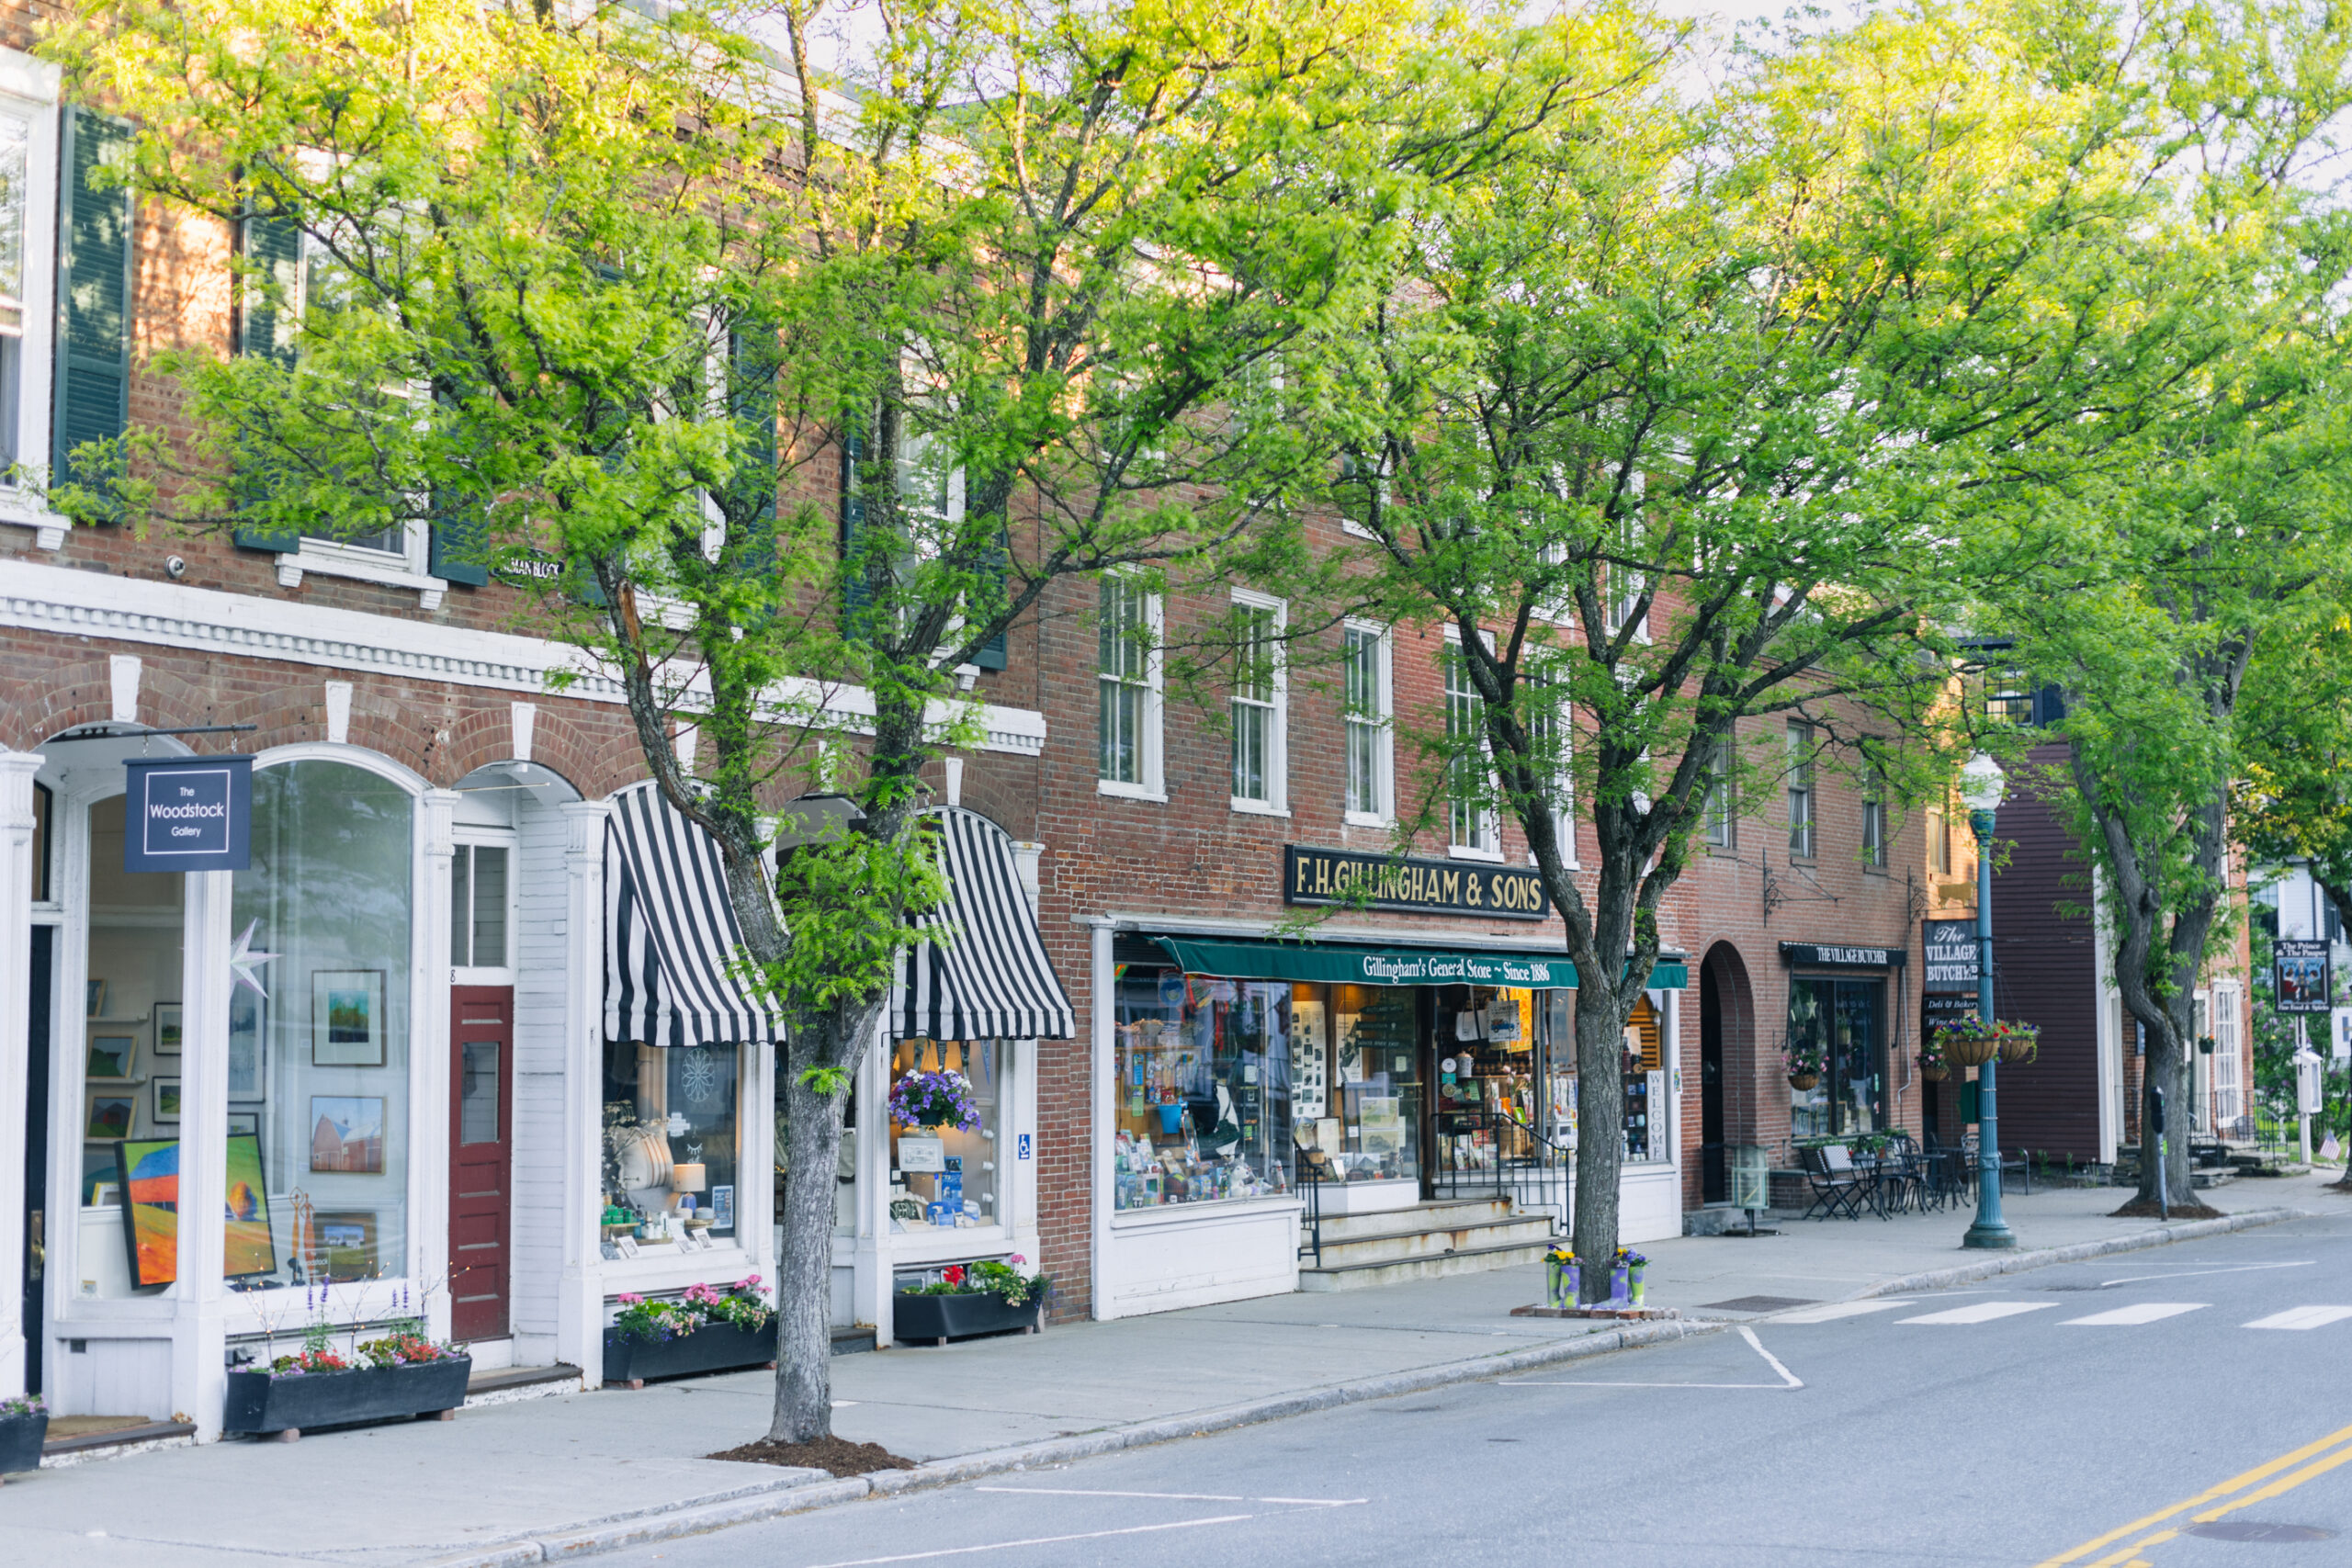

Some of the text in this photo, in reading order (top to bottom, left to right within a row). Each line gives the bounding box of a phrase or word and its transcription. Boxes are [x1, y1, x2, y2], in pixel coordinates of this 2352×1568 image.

[179, 786, 195, 797] The
[150, 802, 224, 819] Woodstock
[171, 826, 201, 838] Gallery
[1465, 873, 1483, 907] &
[1491, 874, 1543, 911] SONS
[1934, 925, 1966, 942] The
[1816, 947, 1888, 964] THE VILLAGE BUTCHER
[1926, 944, 1977, 962] VILLAGE
[1363, 955, 1426, 985] Gillingham's
[1428, 957, 1465, 978] General
[1466, 959, 1492, 979] Store
[1503, 961, 1530, 981] Since
[1531, 963, 1551, 982] 1886
[1928, 999, 1978, 1010] Deli & Bakery
[1928, 1017, 1948, 1026] Wine
[1650, 1074, 1662, 1158] WELCOME
